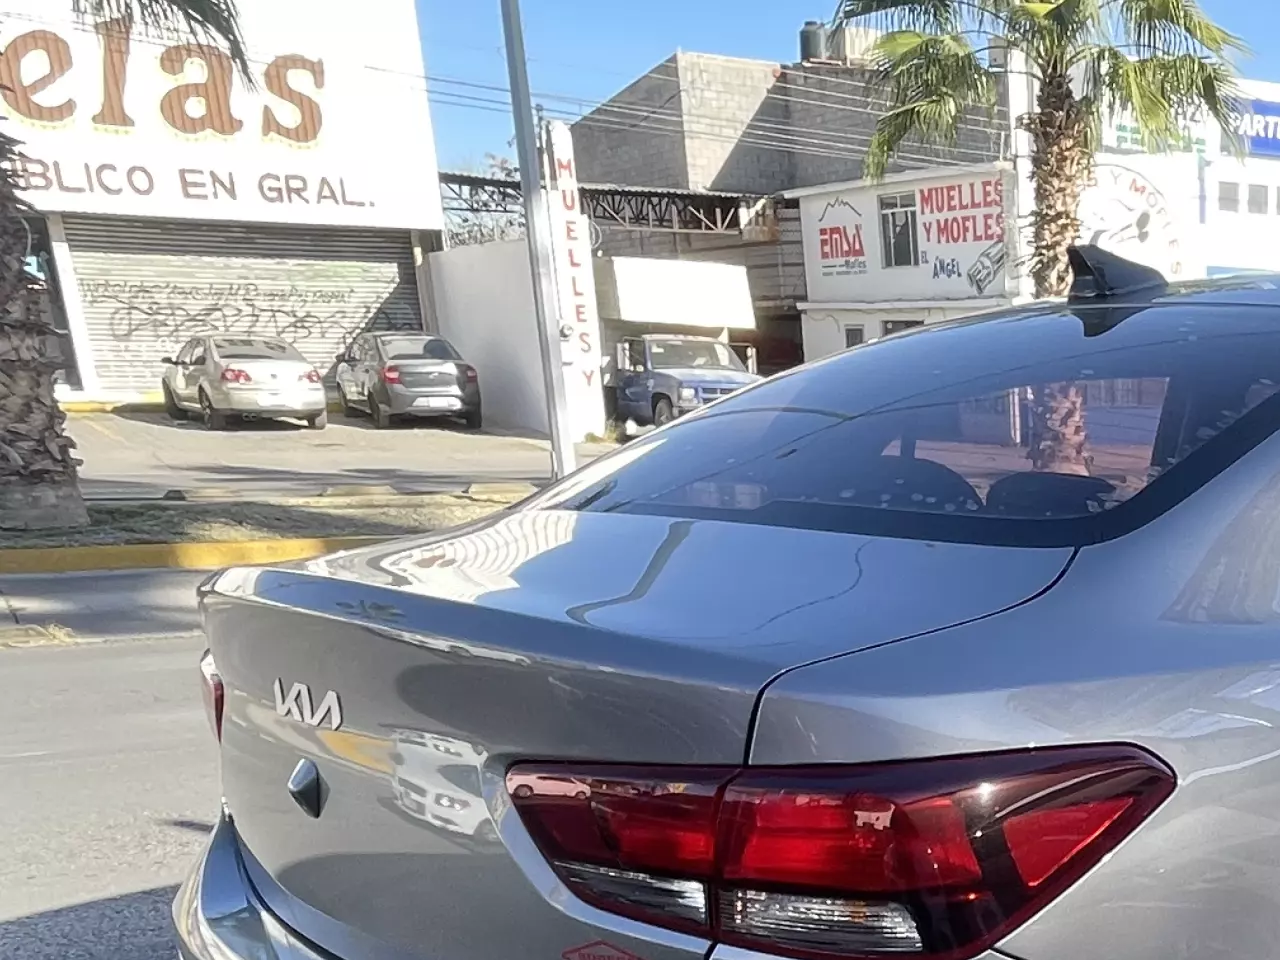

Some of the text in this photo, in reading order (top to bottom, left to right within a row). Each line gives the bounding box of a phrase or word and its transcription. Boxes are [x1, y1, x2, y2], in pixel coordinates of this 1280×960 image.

[0, 17, 325, 143] elas
[178, 168, 237, 200] EN
[258, 172, 375, 207] GRAL.
[919, 178, 1004, 215] MUELLES
[922, 212, 1005, 244] Y MOFLES
[556, 158, 595, 386] MUELLES Y
[921, 250, 962, 280] EL ÁNGEL
[273, 677, 343, 731] KIA
